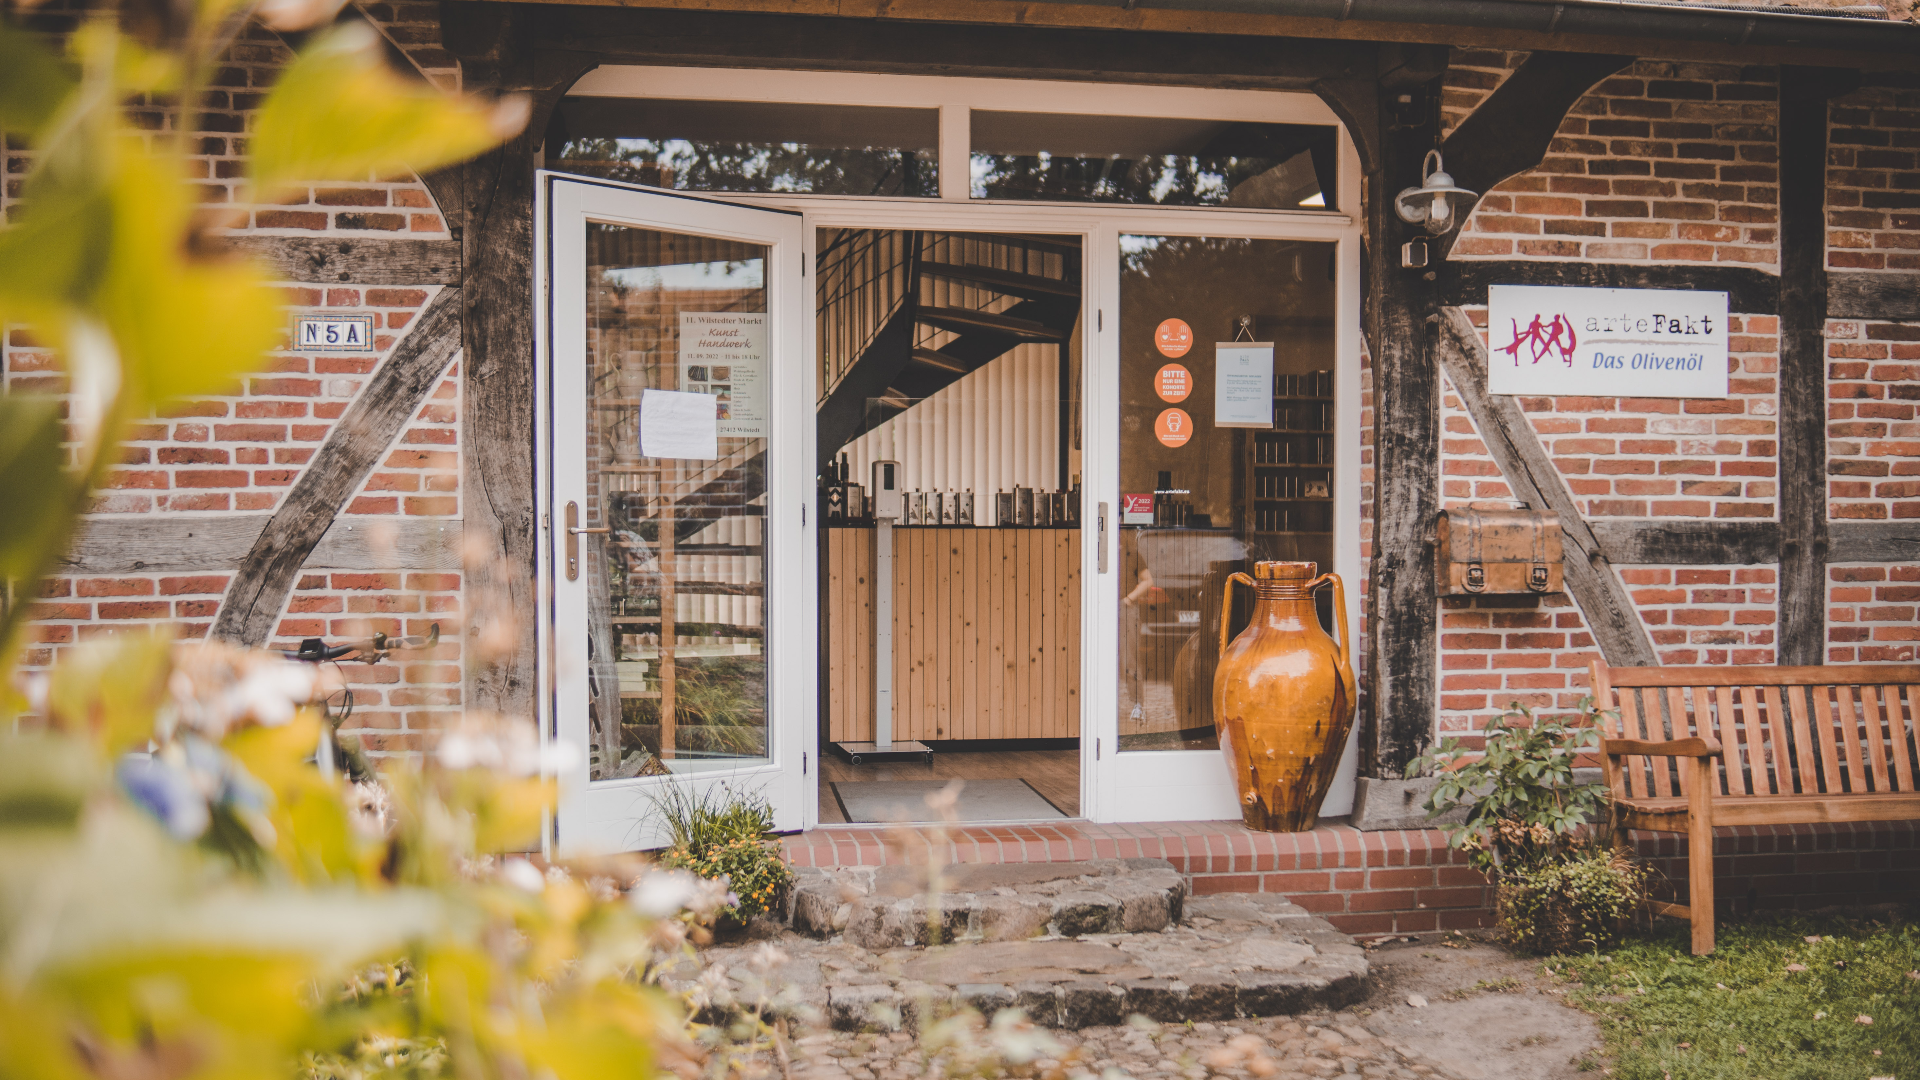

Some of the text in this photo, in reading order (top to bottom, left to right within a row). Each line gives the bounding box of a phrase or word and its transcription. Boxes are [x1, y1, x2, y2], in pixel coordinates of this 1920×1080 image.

[698, 316, 736, 324] Wilstedter
[738, 317, 762, 325] Markt
[1585, 313, 1713, 335] arteFakt
[326, 324, 339, 344] 5
[346, 324, 360, 343] A
[708, 328, 740, 337] Kunst
[698, 338, 752, 349] Handwerk
[1592, 352, 1704, 371] Das Olivenöl
[1162, 370, 1186, 378] BITTE
